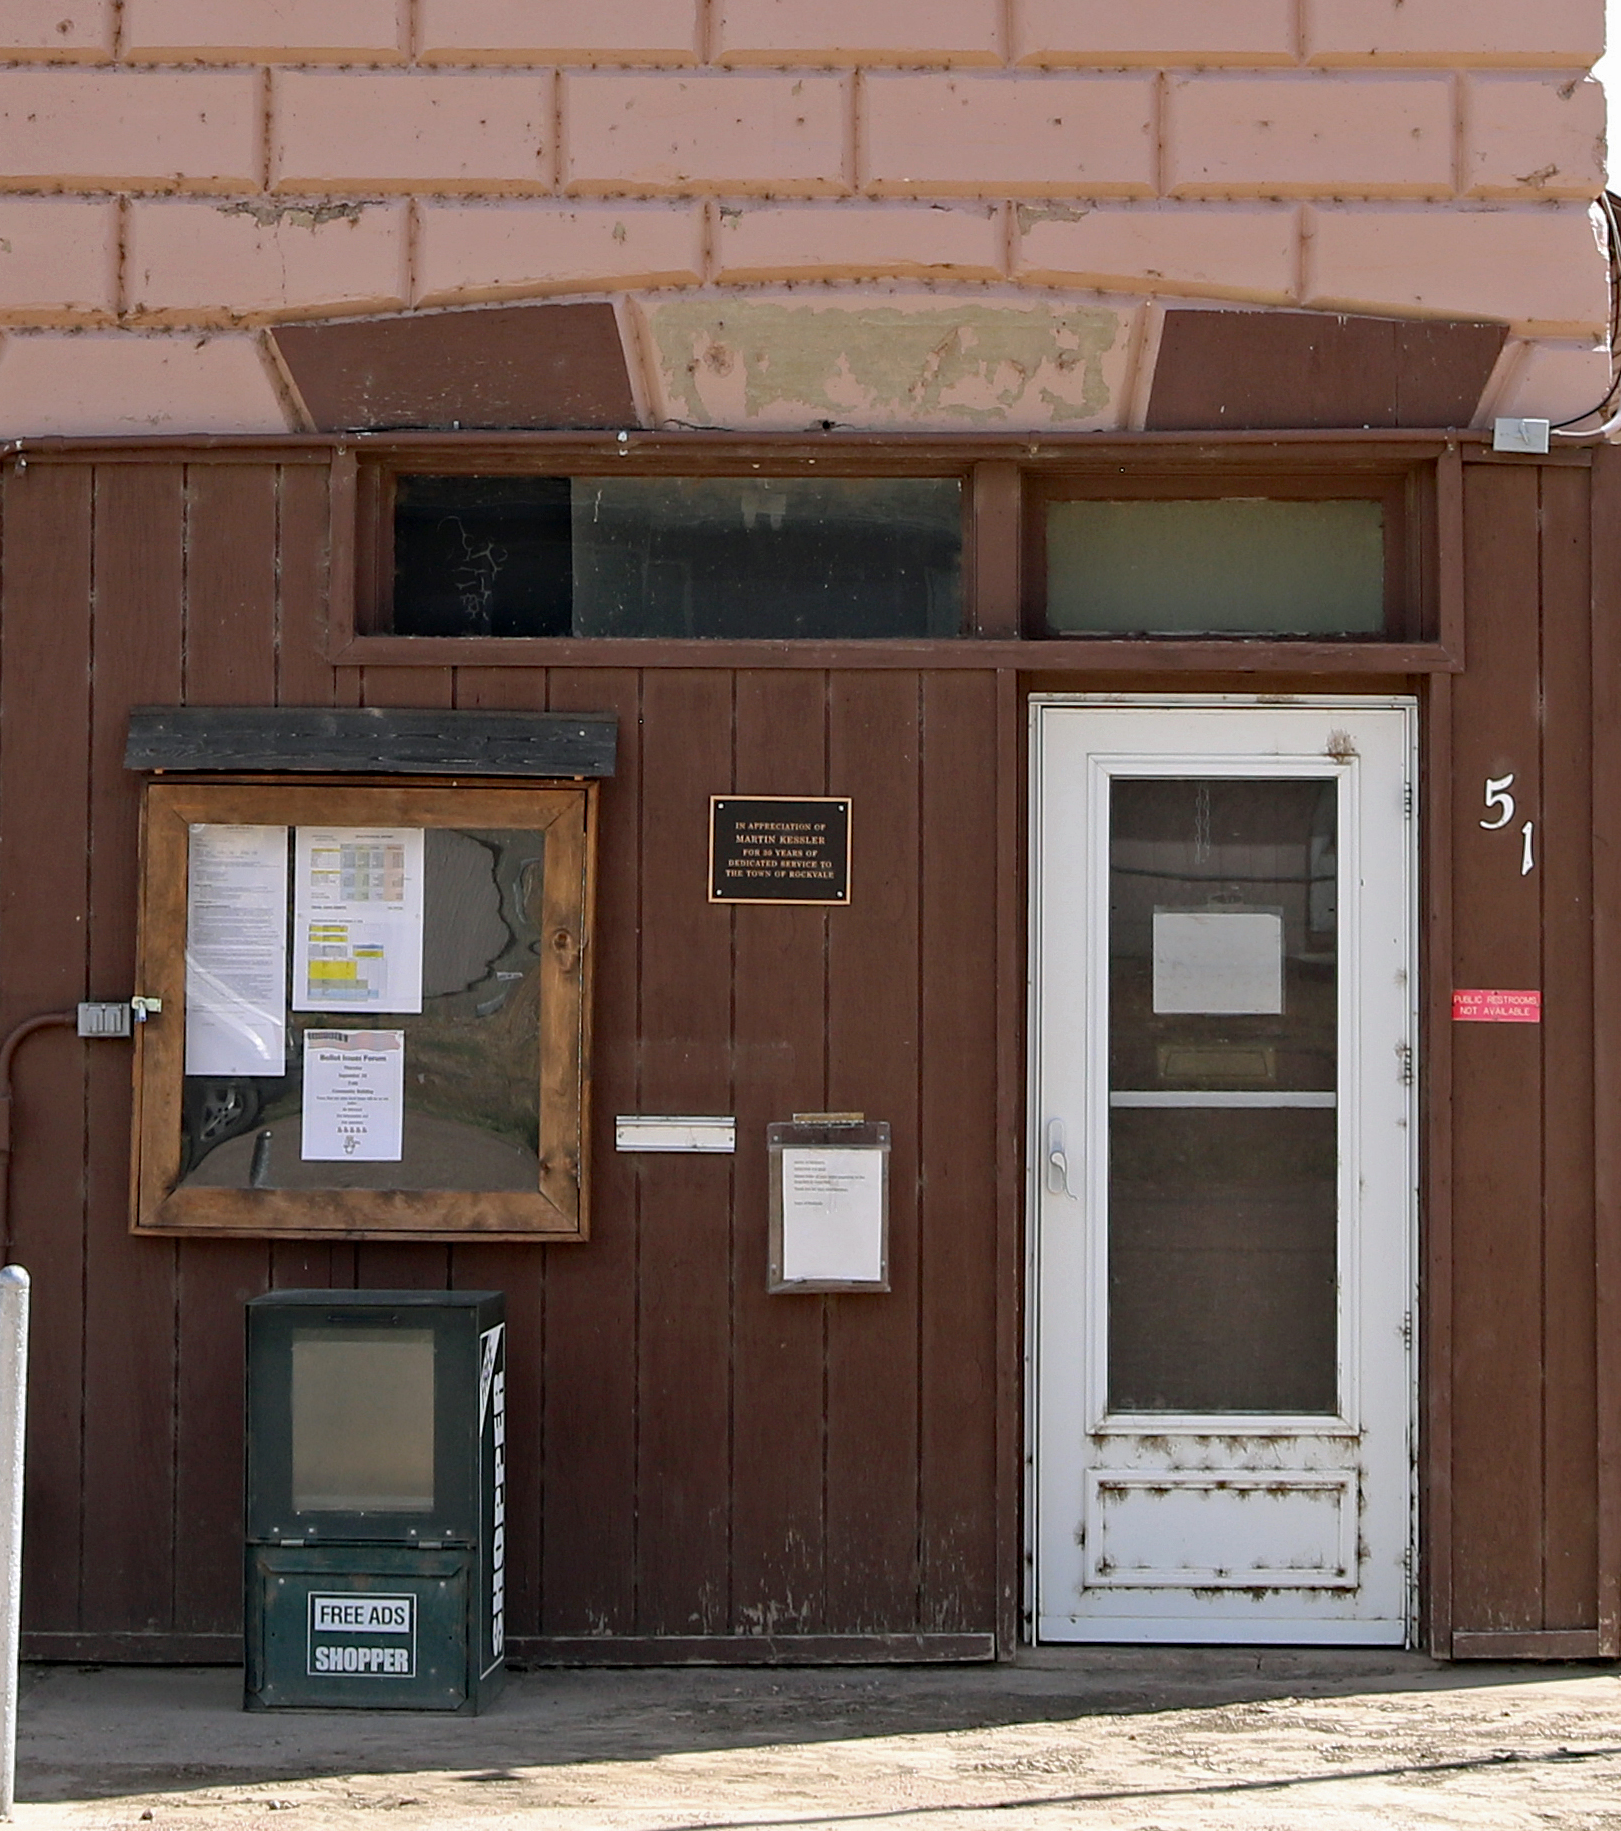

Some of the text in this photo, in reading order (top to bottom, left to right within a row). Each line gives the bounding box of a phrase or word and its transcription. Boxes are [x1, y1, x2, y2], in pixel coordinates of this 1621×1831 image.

[735, 822, 826, 831] IN APPRECIATION OF
[736, 834, 826, 845] MARTIN KESSLER
[742, 848, 760, 857] FOR
[774, 848, 803, 857] YEARS
[805, 849, 818, 858] OF
[728, 859, 832, 869] DEDICATED SERVICE TO
[725, 869, 835, 880] THE TOWN OF ROCKVALE
[1453, 995, 1537, 1005] PUBLIC RESTROOMS
[1460, 1006, 1530, 1016] NOT AVAILABLE
[492, 1371, 505, 1657] SHOPPER
[320, 1604, 406, 1626] FREE ADS
[314, 1645, 409, 1673] SHOPPER
